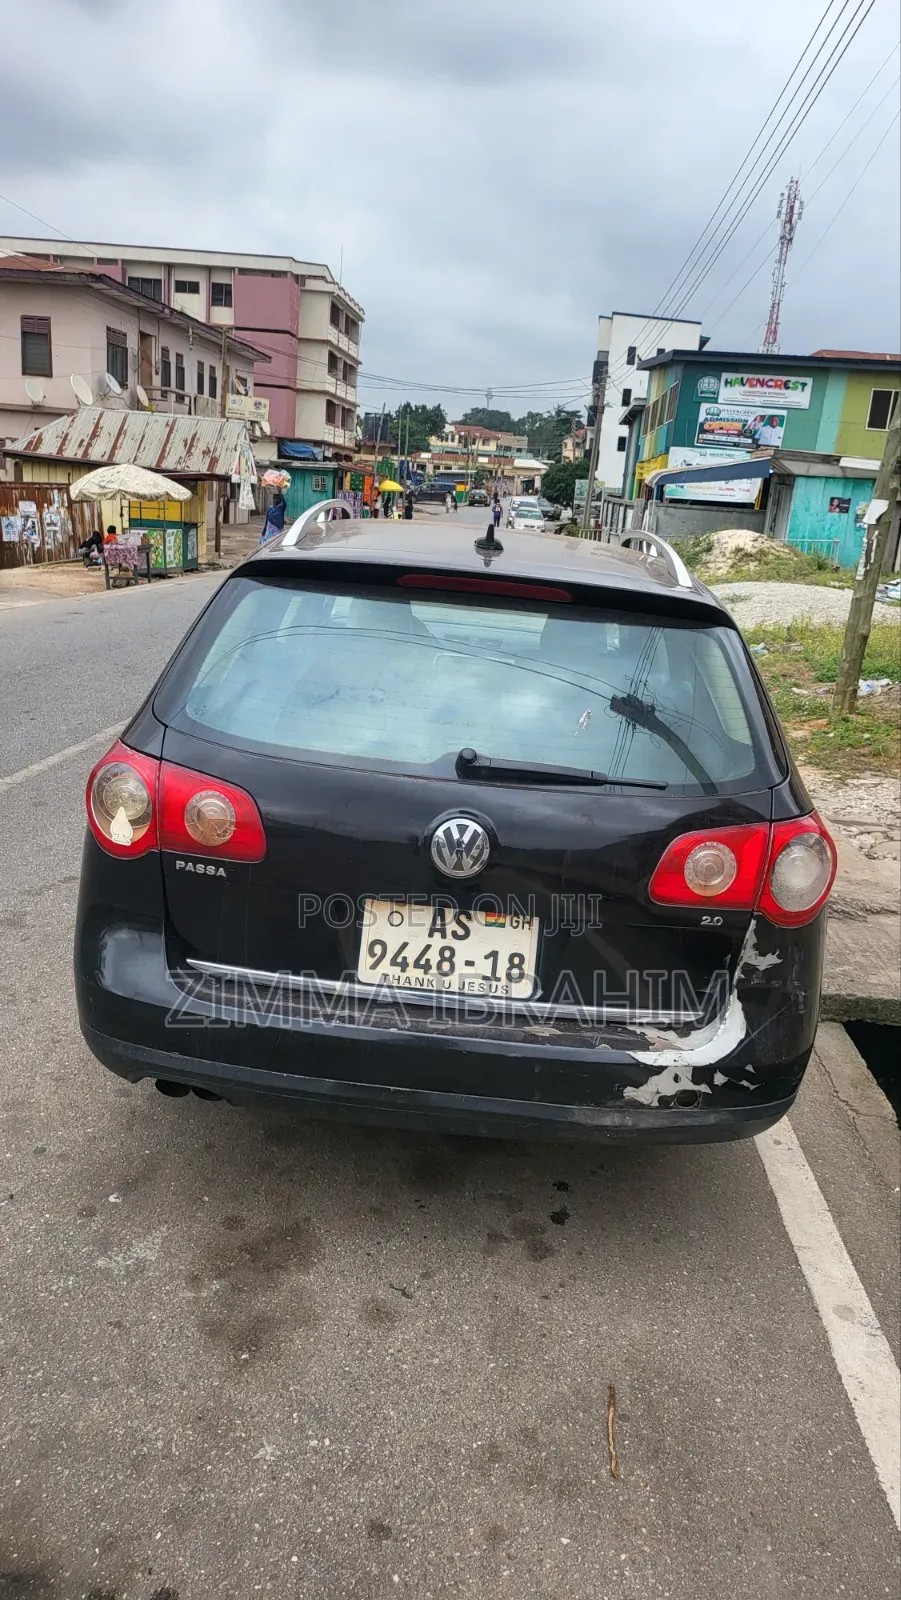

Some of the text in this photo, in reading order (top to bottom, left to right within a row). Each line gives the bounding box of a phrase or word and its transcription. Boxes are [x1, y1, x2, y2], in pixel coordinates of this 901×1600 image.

[724, 376, 808, 393] HAVENCREST
[721, 408, 757, 416] HAVENCREST
[175, 860, 227, 877] PASSA
[428, 907, 533, 941] AS GH
[368, 938, 526, 983] 9448-18
[381, 972, 509, 995] THANK U JESUS
